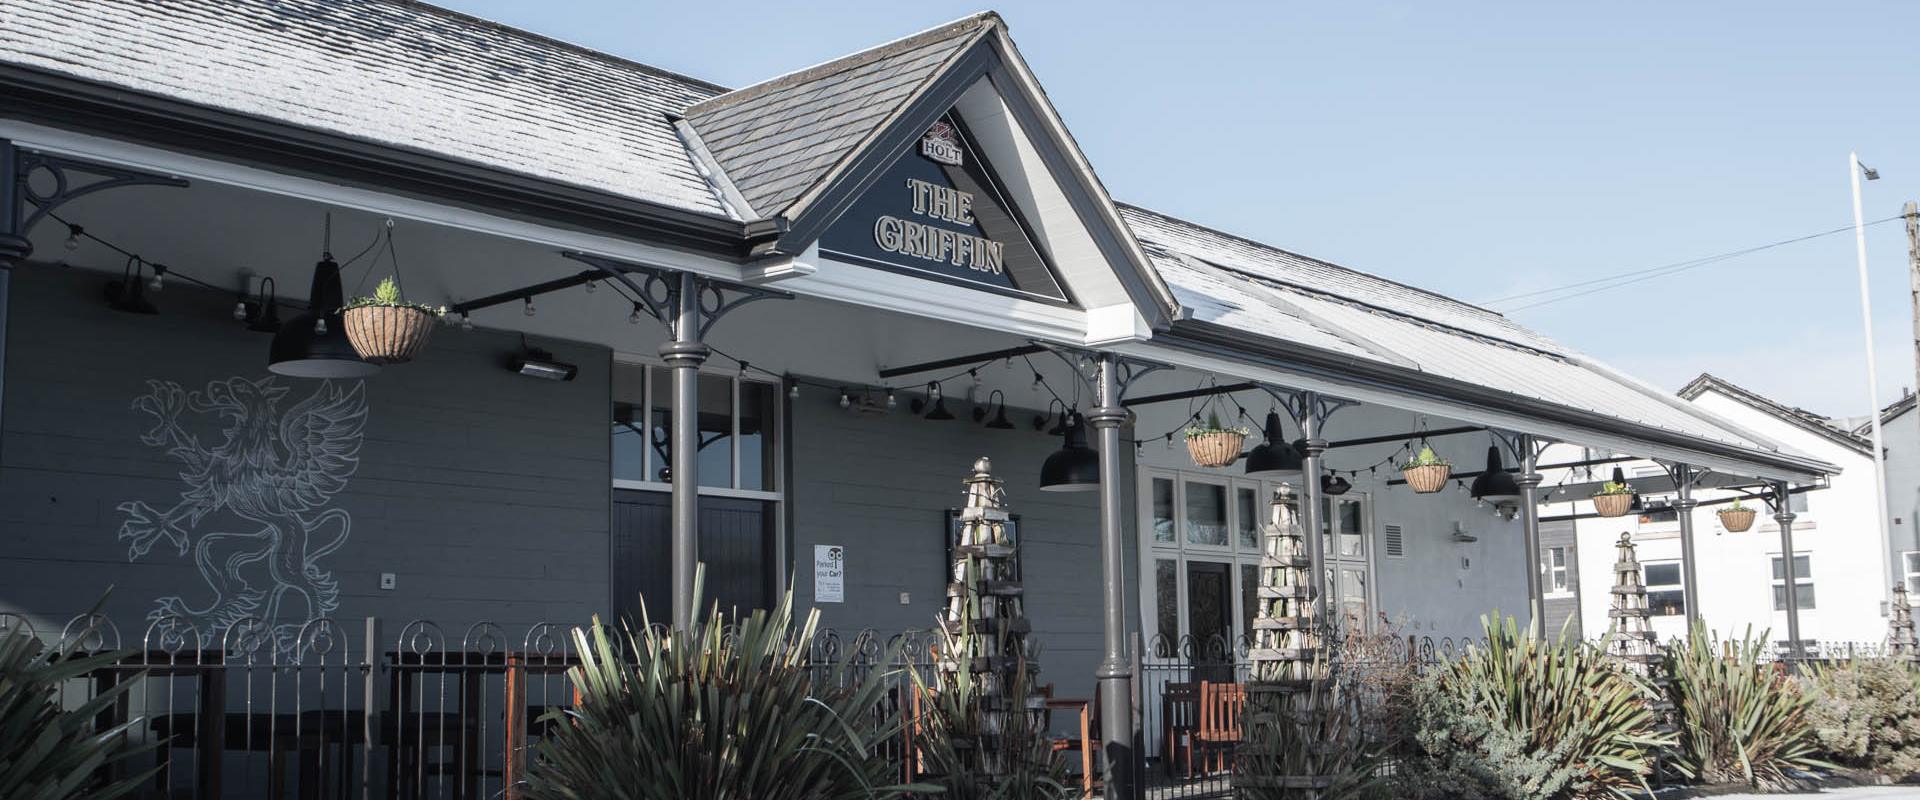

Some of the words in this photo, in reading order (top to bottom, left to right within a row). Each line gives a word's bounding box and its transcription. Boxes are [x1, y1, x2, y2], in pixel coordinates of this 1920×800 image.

[925, 141, 961, 161] HOLT
[906, 178, 975, 226] THE
[874, 215, 1004, 275] GRIFFIN
